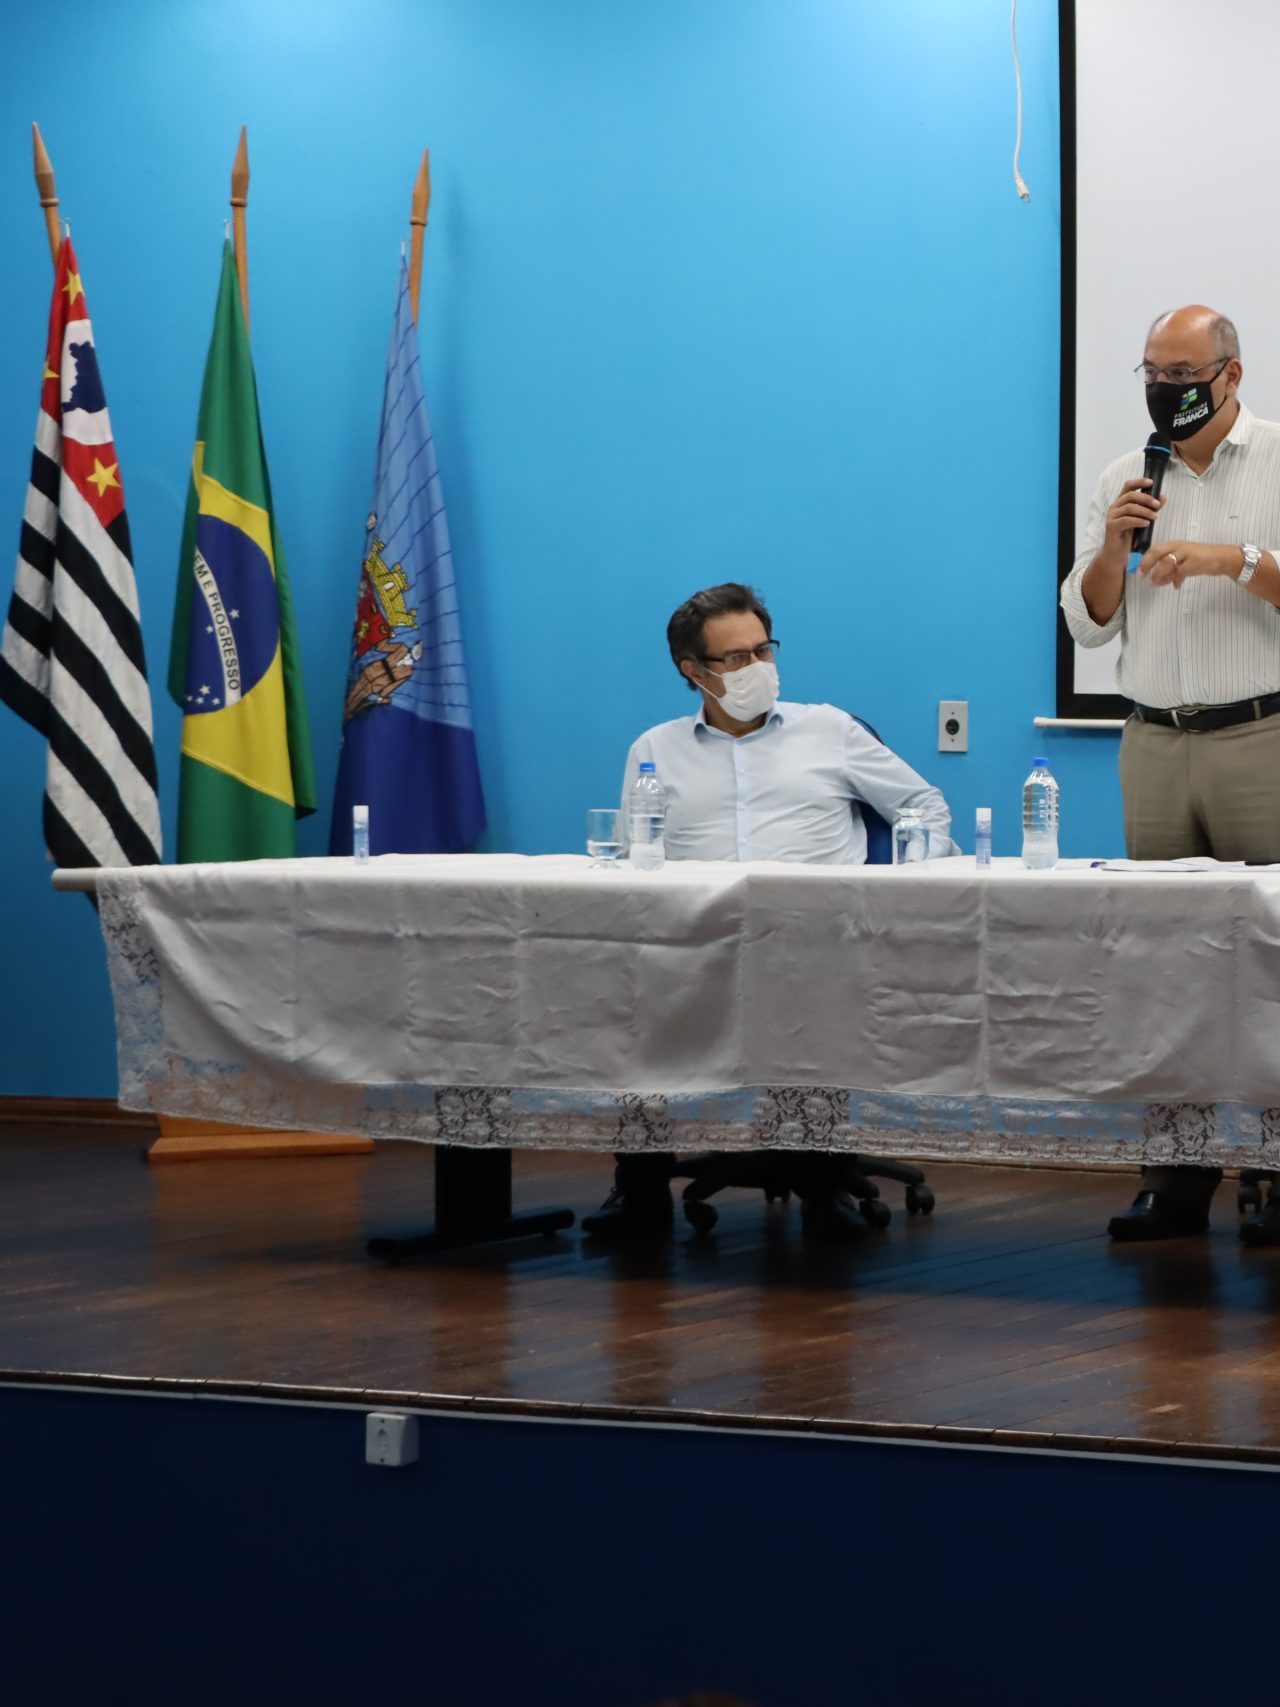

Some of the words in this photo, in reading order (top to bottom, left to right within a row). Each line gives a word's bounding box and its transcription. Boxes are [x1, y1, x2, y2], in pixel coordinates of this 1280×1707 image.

[1172, 406, 1209, 428] FRANCA
[202, 580, 214, 590] E
[208, 592, 241, 690] PROGRESSO
